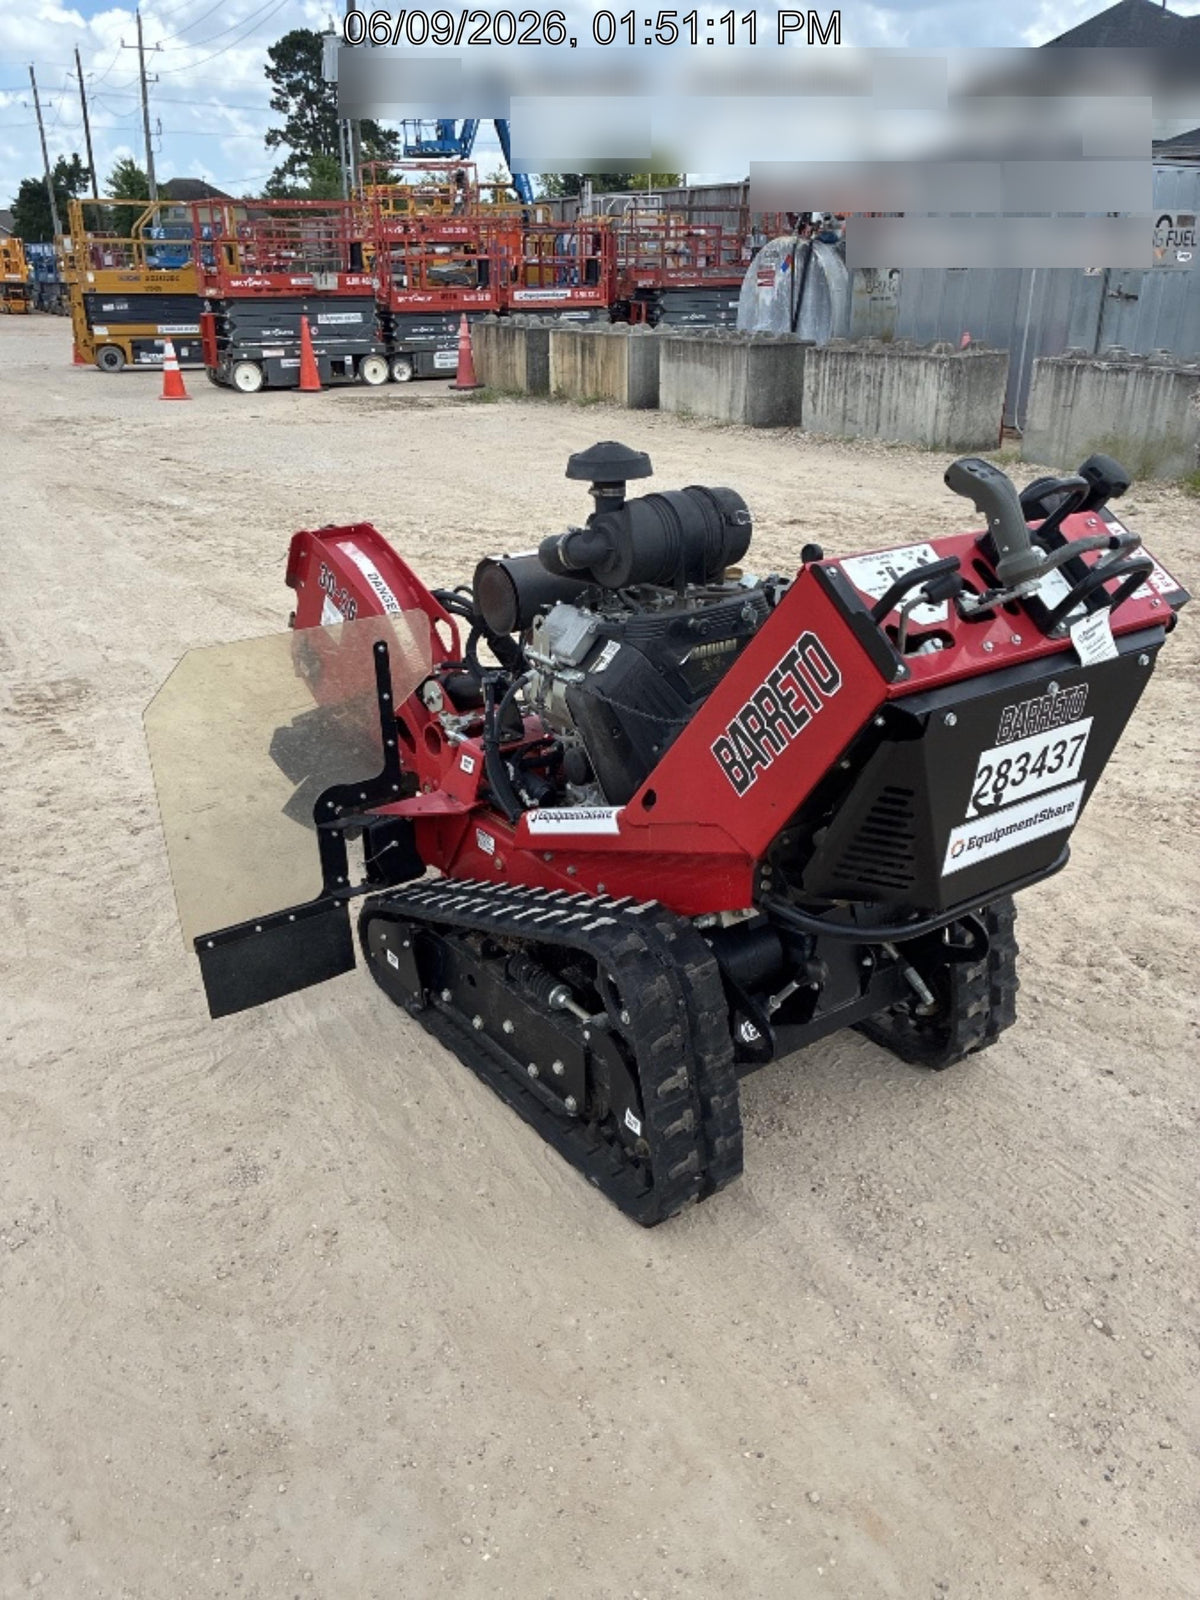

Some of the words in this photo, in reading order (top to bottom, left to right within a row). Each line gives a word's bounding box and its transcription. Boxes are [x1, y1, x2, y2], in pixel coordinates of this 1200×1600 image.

[1166, 230, 1197, 247] FUEL
[710, 630, 842, 797] BARRETO
[995, 683, 1089, 745] BARRETO
[972, 731, 1087, 800] 283437
[966, 801, 1075, 850] EquipmentShare
